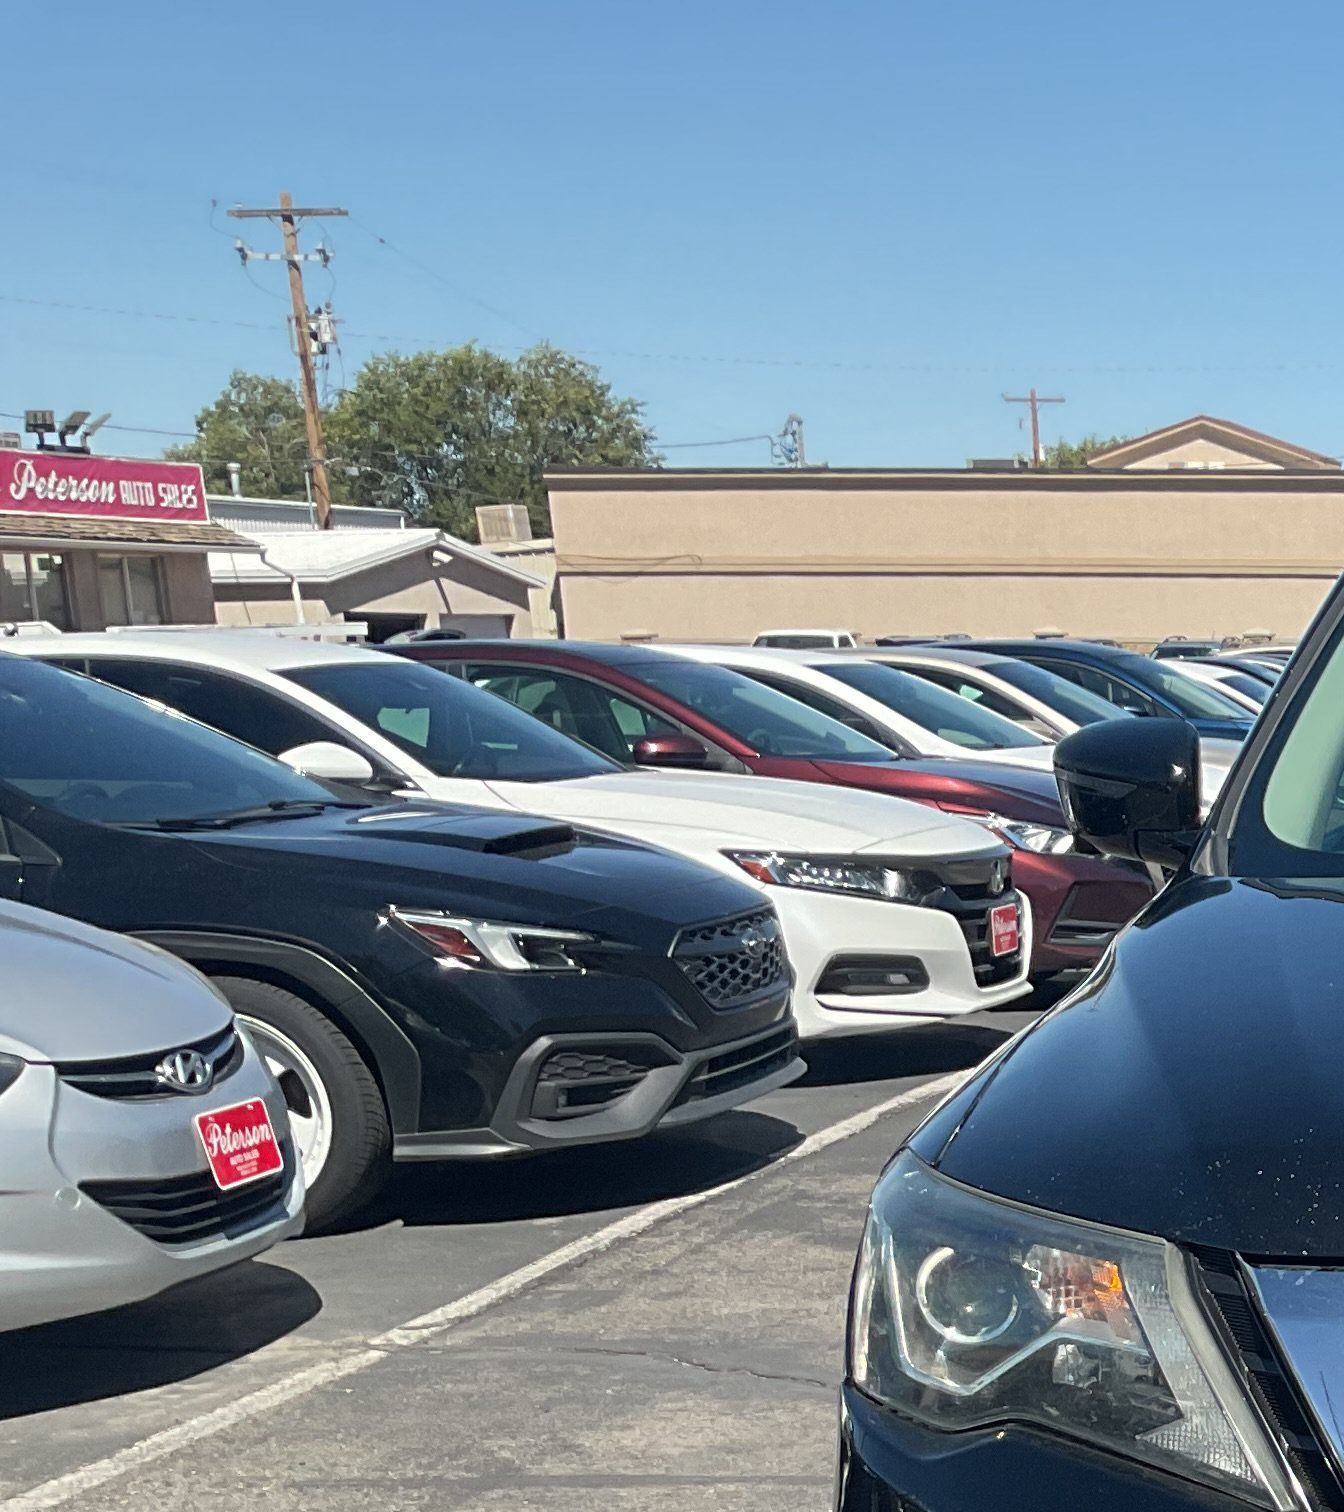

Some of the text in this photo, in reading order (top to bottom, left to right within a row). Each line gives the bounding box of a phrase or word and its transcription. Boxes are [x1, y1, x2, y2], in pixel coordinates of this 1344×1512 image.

[10, 459, 198, 509] Peterson AUTO SALES
[205, 1122, 272, 1158] Peterson
